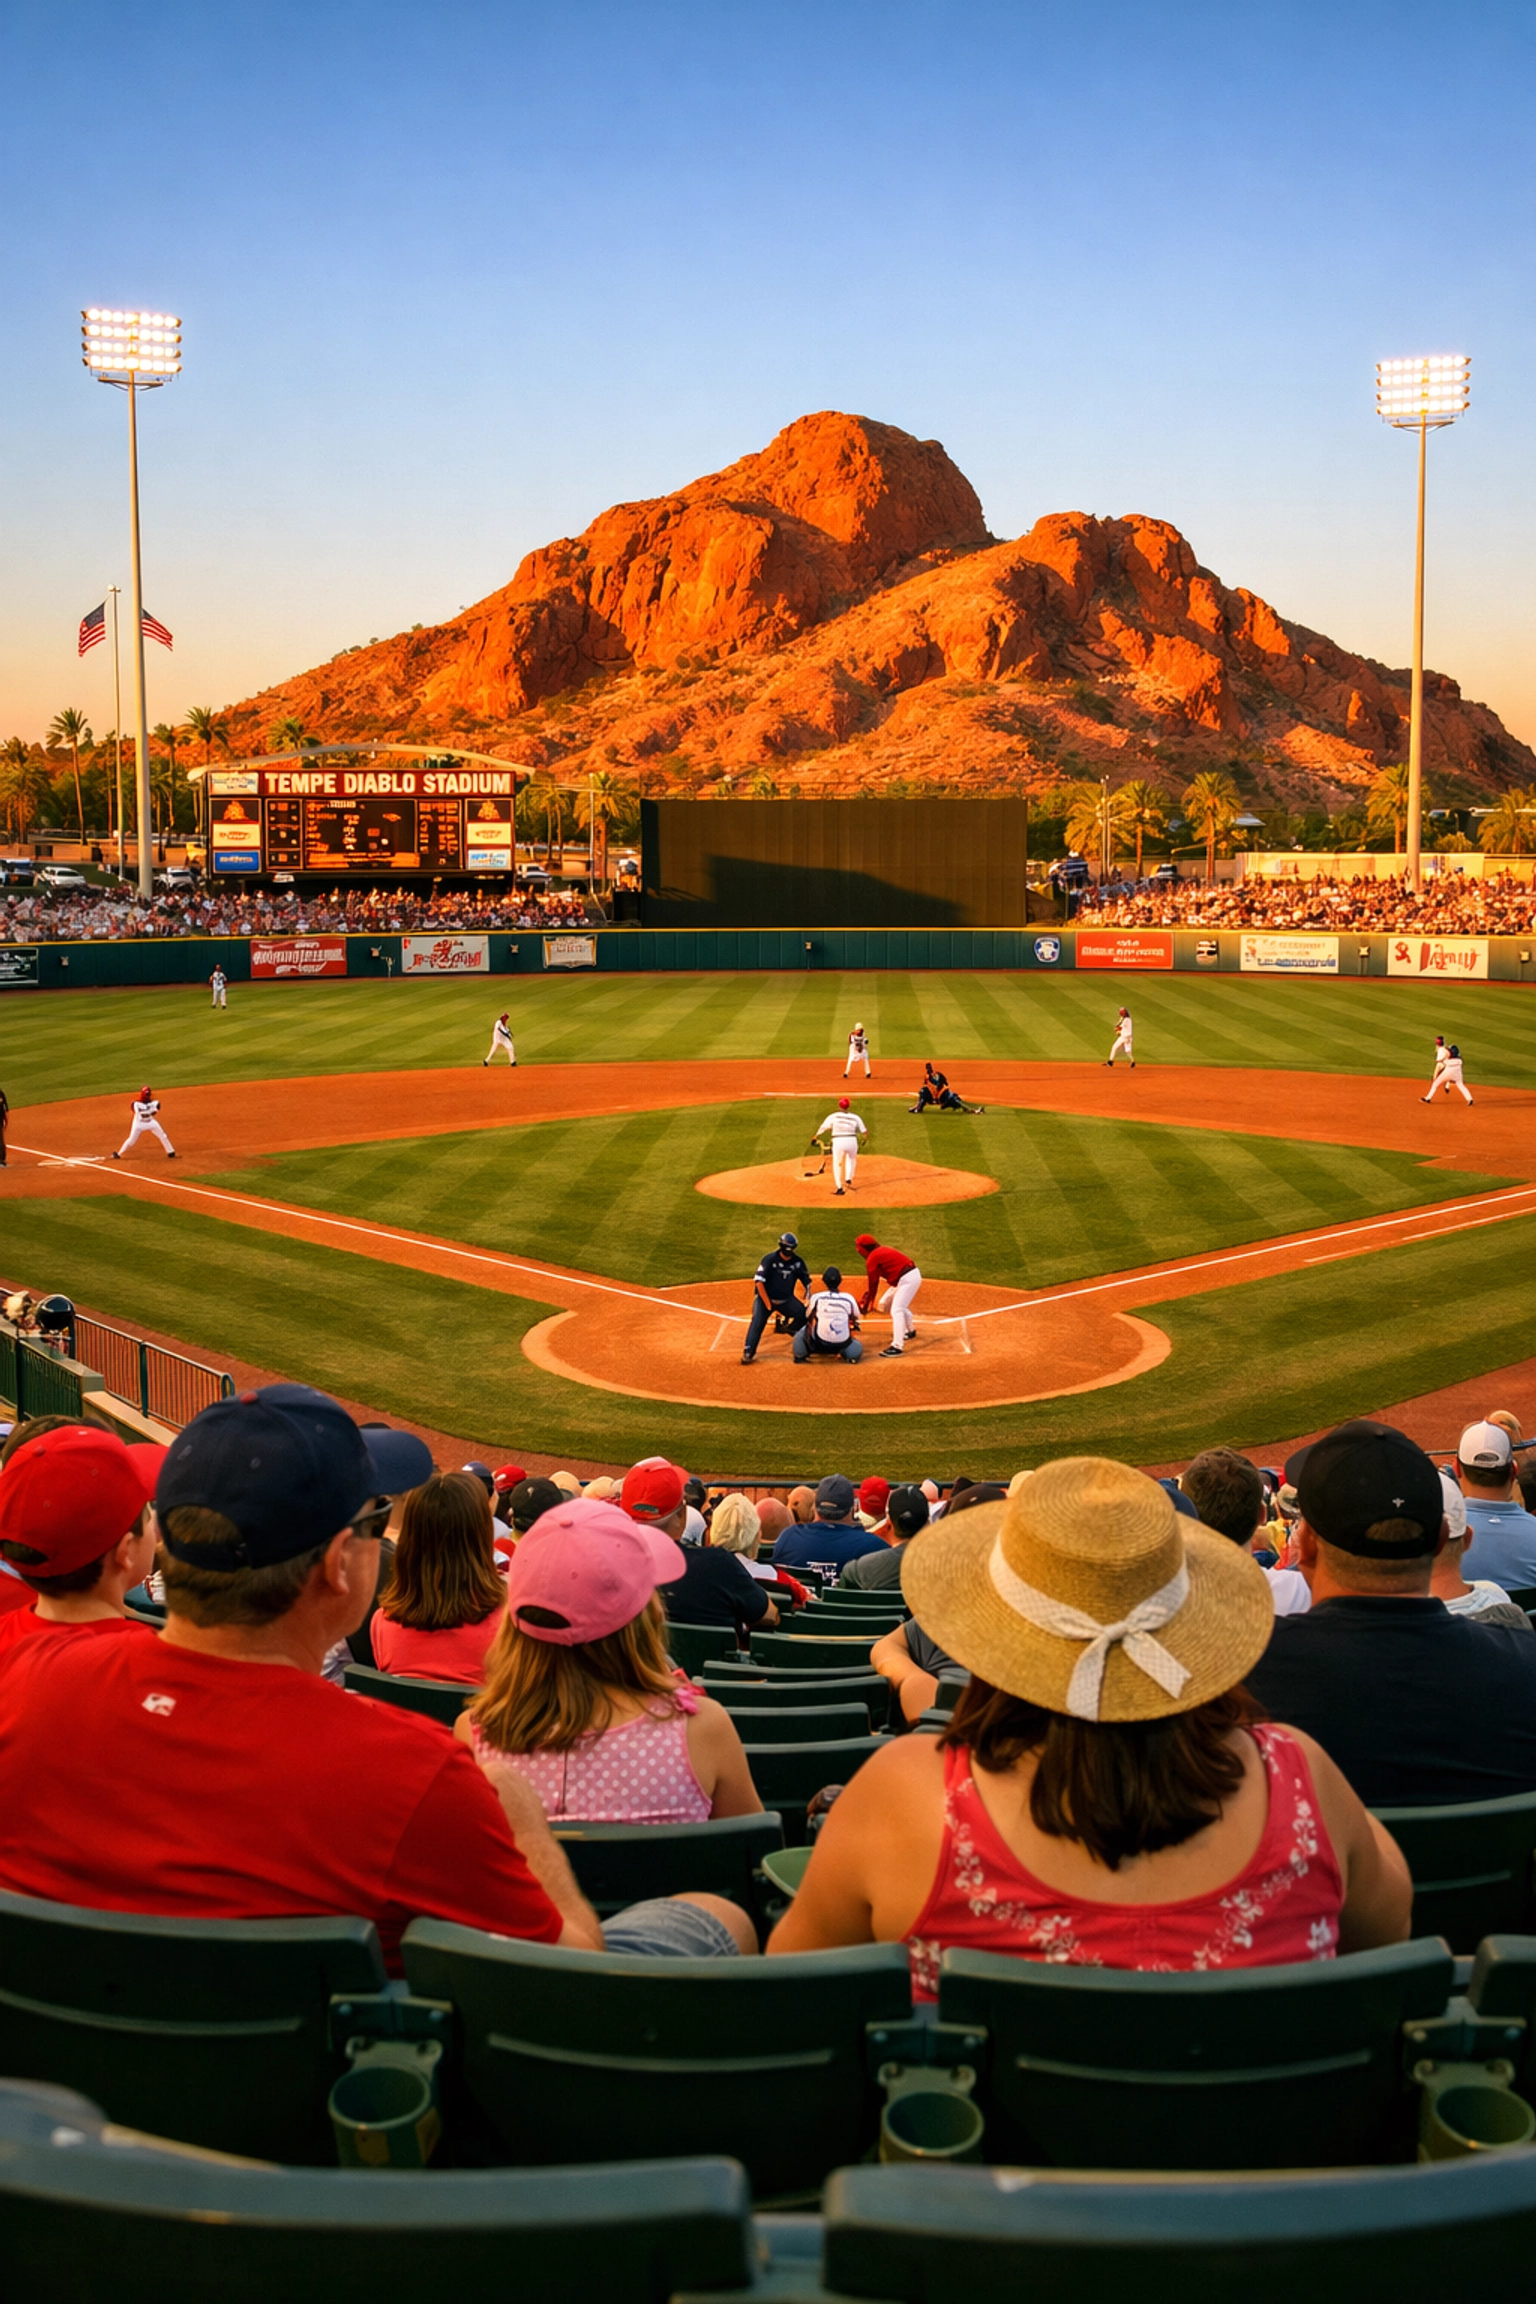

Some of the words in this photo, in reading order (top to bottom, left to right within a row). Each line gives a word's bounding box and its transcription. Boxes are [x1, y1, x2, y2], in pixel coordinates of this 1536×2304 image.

[264, 773, 336, 793] TEMPE
[344, 773, 415, 793] DIABLO
[423, 773, 510, 794] STADIUM
